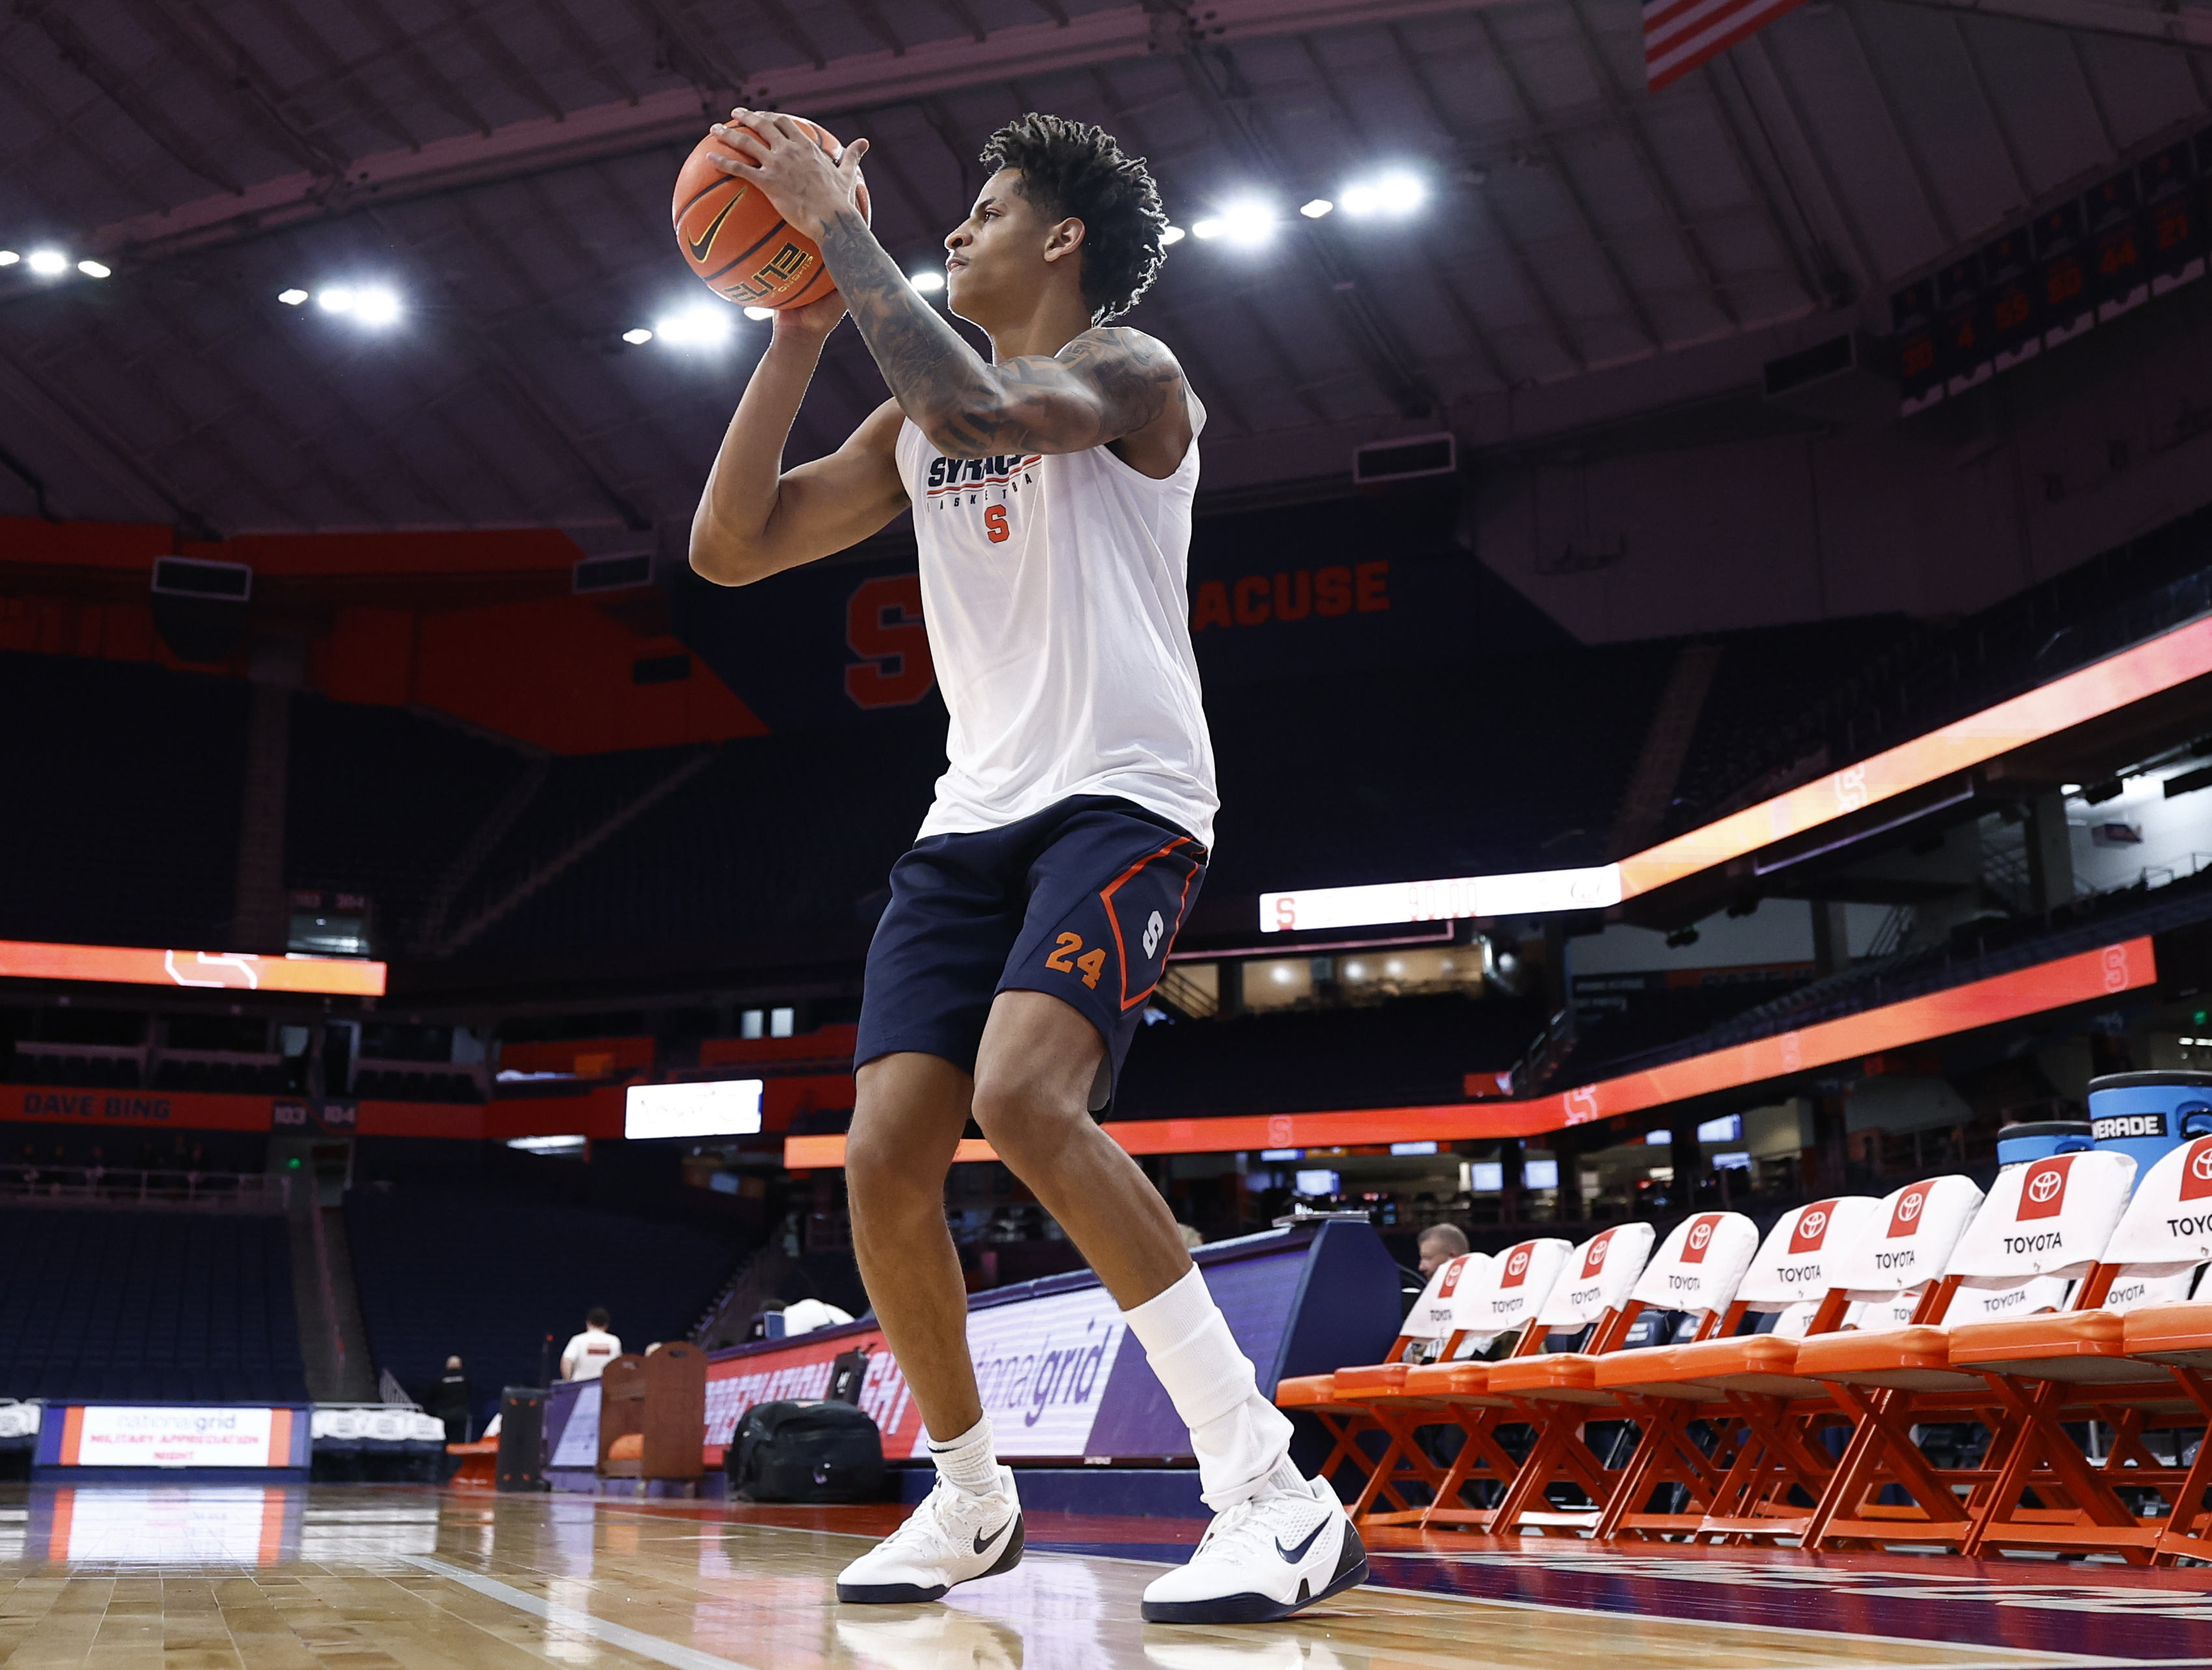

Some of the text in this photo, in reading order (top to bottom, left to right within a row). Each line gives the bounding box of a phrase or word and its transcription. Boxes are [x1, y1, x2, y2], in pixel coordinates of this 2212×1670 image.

[928, 455, 1028, 487] SYRAC
[984, 504, 1010, 543] S
[1191, 560, 1391, 632] ACUSE
[845, 573, 936, 710] S
[1276, 898, 1296, 930] S
[1045, 931, 1106, 990] 24
[23, 1094, 171, 1120] DAVE BING
[2004, 1232, 2062, 1254] TOYOTA
[1875, 1250, 1914, 1269] TOYOTA
[1668, 1275, 1700, 1291] TOYOTA
[1778, 1265, 1821, 1282] TOYOTA
[1571, 1287, 1601, 1305] TOYOTA
[1983, 1290, 2026, 1312] TOYOTA
[2109, 1283, 2146, 1303] OYOTA
